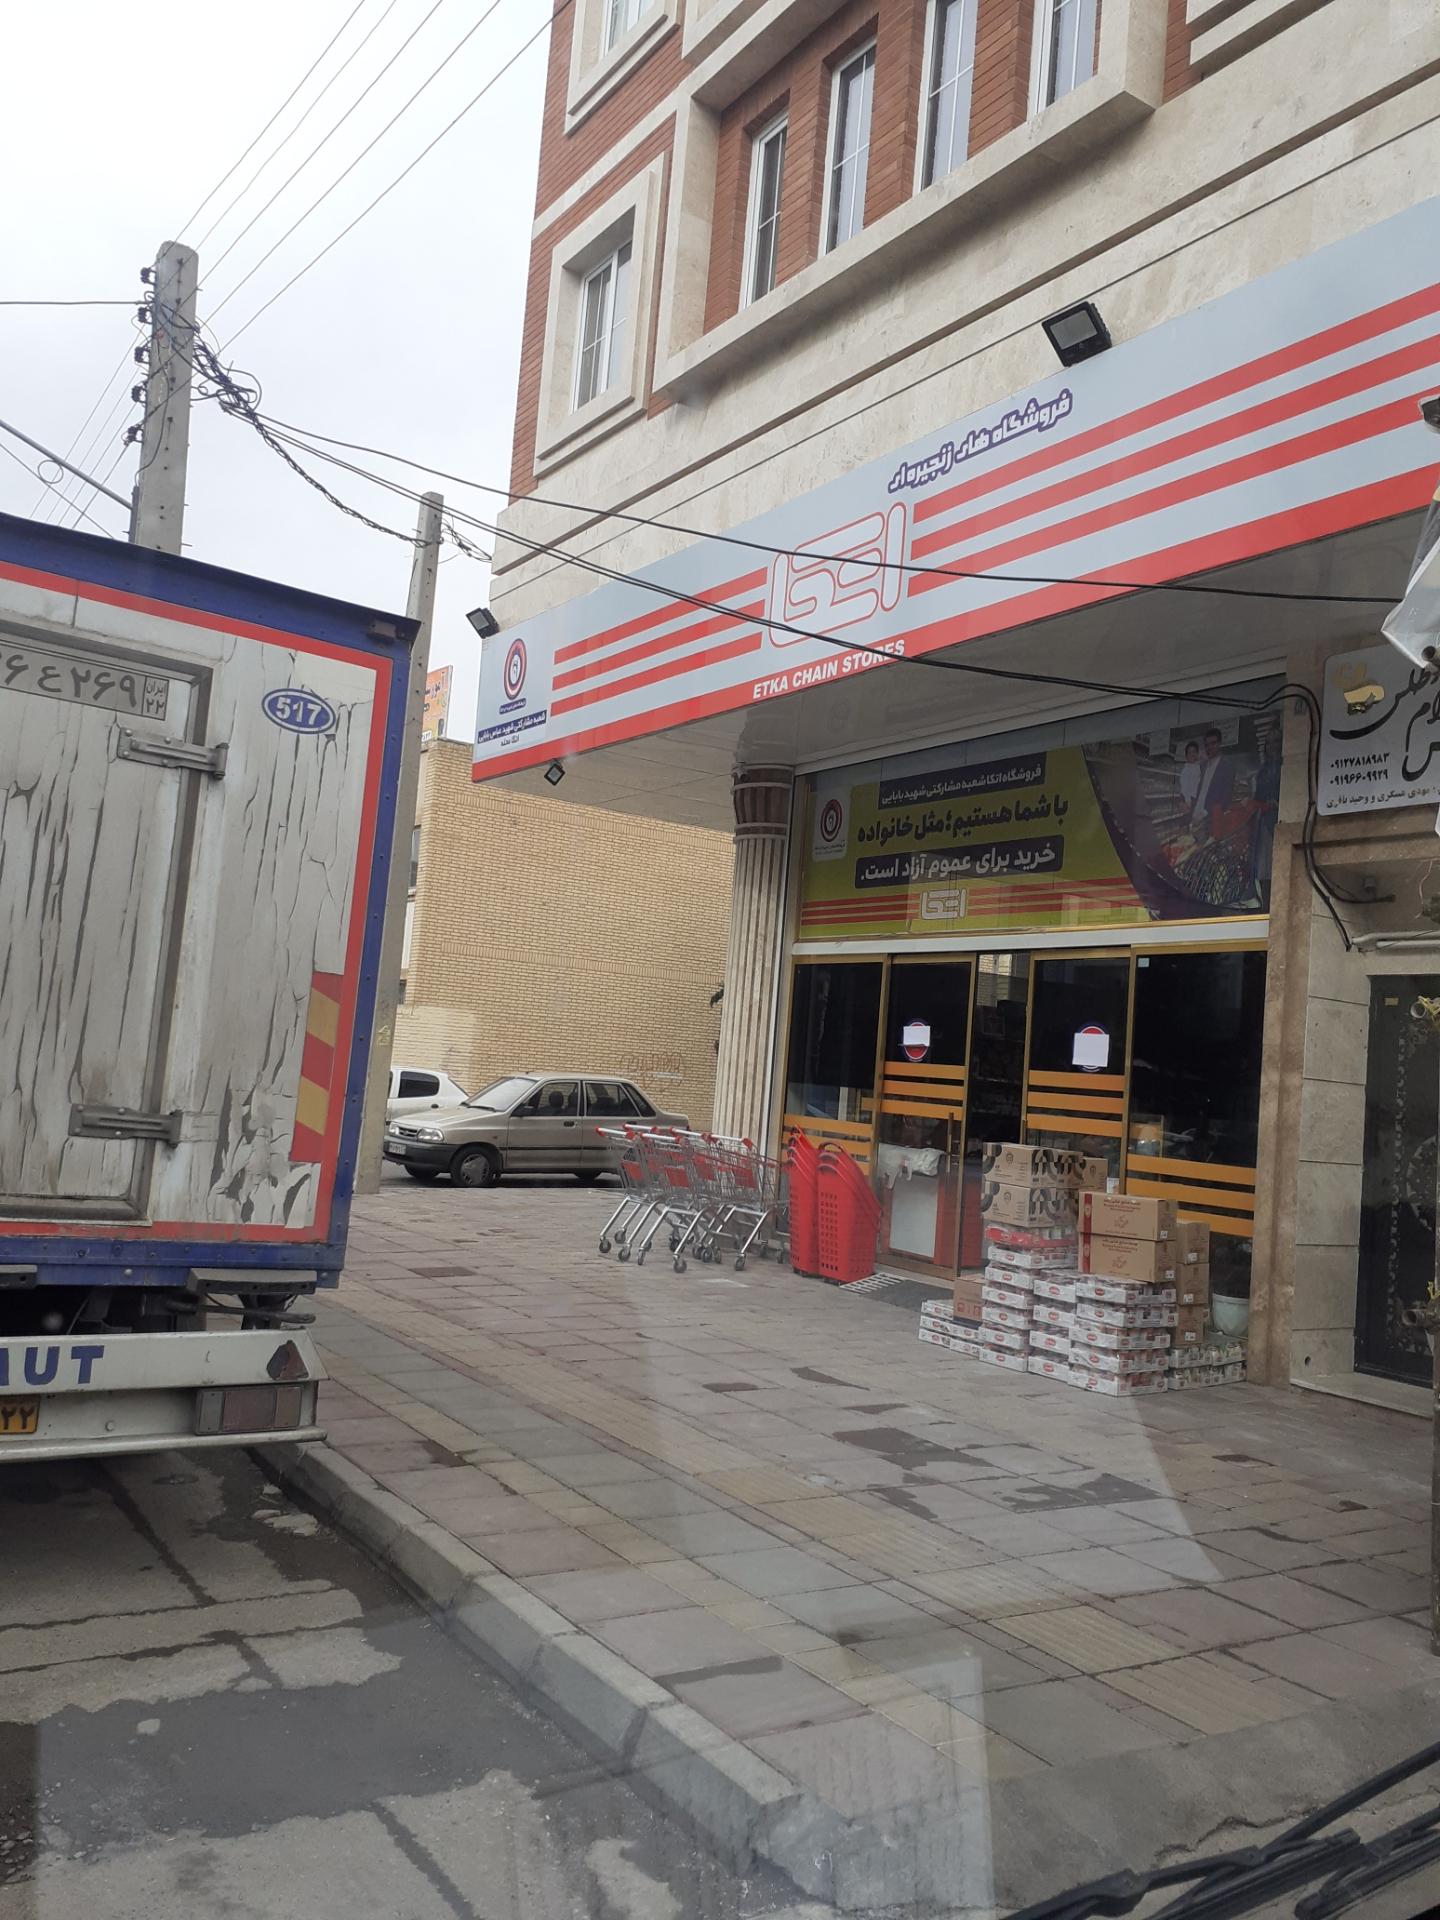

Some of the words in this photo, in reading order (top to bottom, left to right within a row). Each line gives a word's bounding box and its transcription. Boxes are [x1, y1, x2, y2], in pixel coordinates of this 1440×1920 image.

[991, 389, 1072, 446] فروشگاه
[752, 676, 788, 699] ETKA
[792, 661, 838, 687] CHAIN
[842, 640, 905, 673] STORES
[146, 681, 166, 698] ایران
[145, 698, 165, 715] ۲۲
[276, 697, 321, 725] 517
[962, 774, 986, 791] شعبه
[1002, 763, 1042, 783] فروشگاه
[926, 780, 962, 798] مشارکتی
[1014, 794, 1051, 823] شما
[1053, 794, 1069, 826] با
[858, 815, 913, 847] خانواده
[914, 810, 945, 840] مثل
[902, 853, 927, 880] آزاد
[927, 854, 971, 879] عموم
[975, 847, 1010, 875] برای
[1013, 842, 1056, 870] خرید
